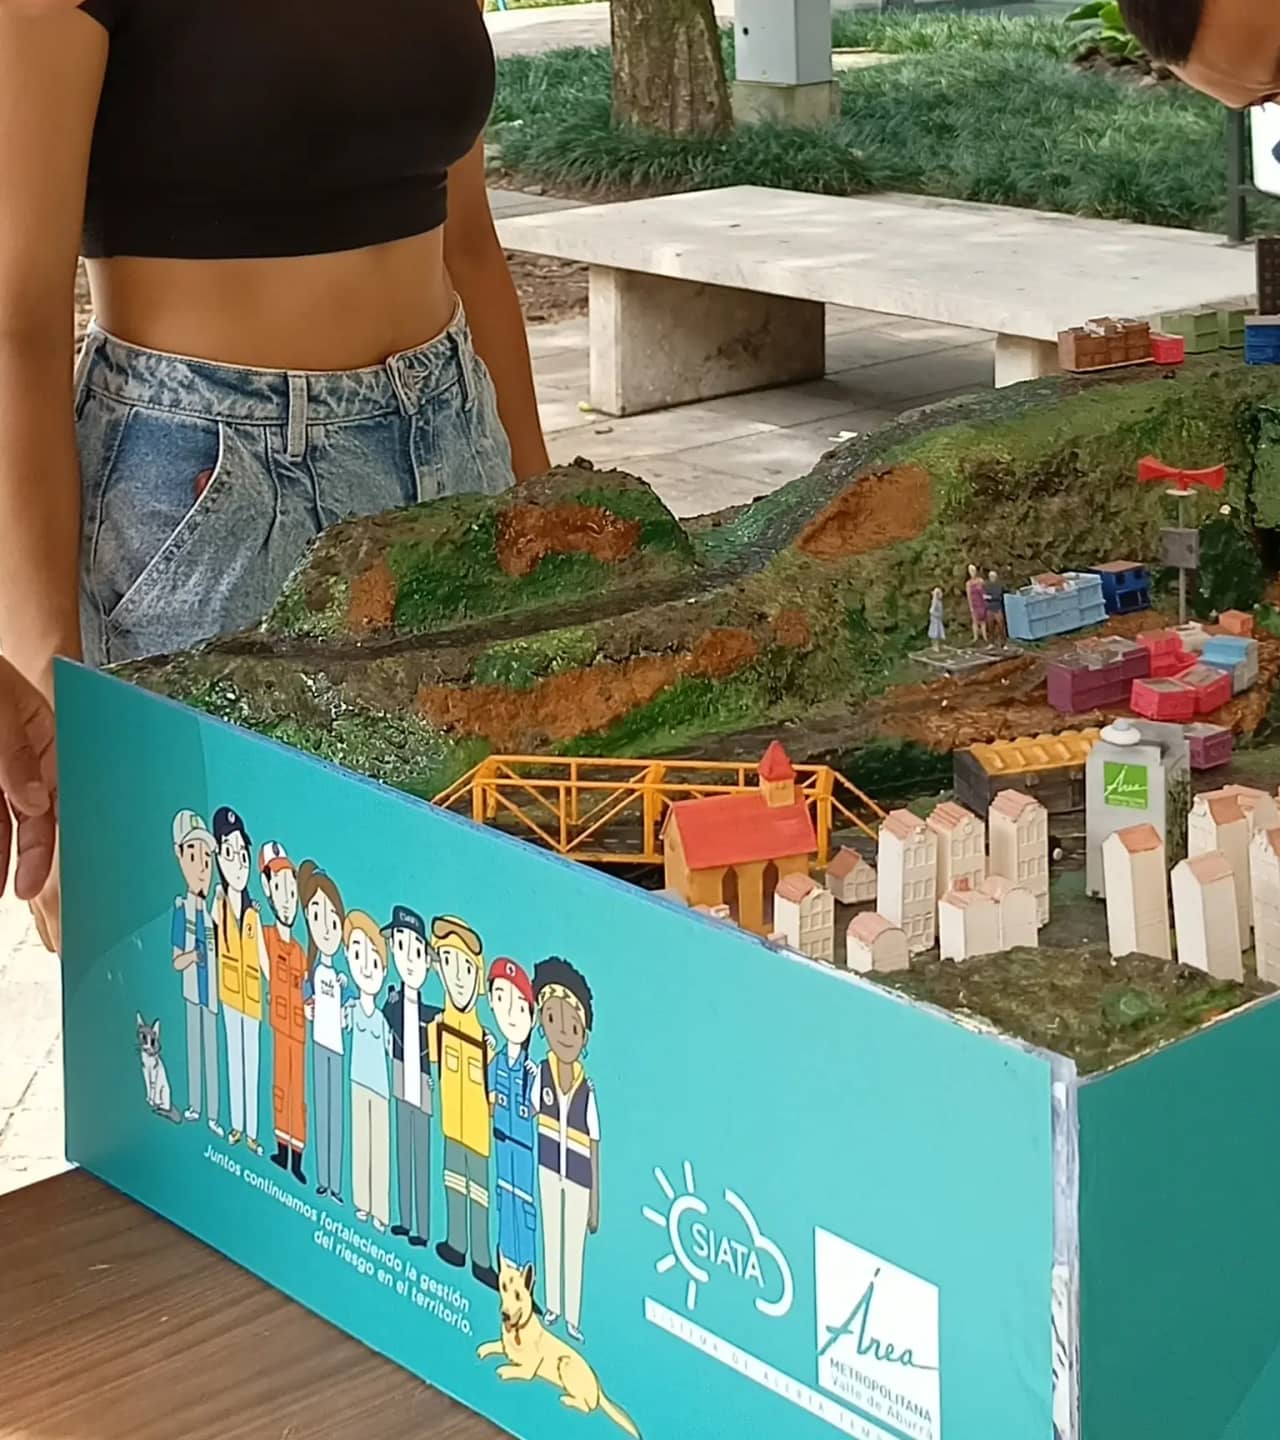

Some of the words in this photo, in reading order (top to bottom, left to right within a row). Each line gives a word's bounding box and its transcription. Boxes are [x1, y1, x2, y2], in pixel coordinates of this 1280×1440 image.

[203, 1144, 242, 1177] Juntos
[243, 1167, 318, 1223] continuamos
[320, 1211, 403, 1273] fortaleciendo
[405, 1260, 417, 1282] la
[421, 1273, 470, 1314] gestión
[691, 1222, 765, 1288] SIATA
[313, 1230, 333, 1252] del
[335, 1245, 374, 1277] riesgo
[377, 1269, 394, 1288] en
[396, 1279, 408, 1298] el
[411, 1286, 473, 1337] territorio.
[816, 1267, 940, 1371] Área
[829, 1356, 933, 1424] METROPOLITANA
